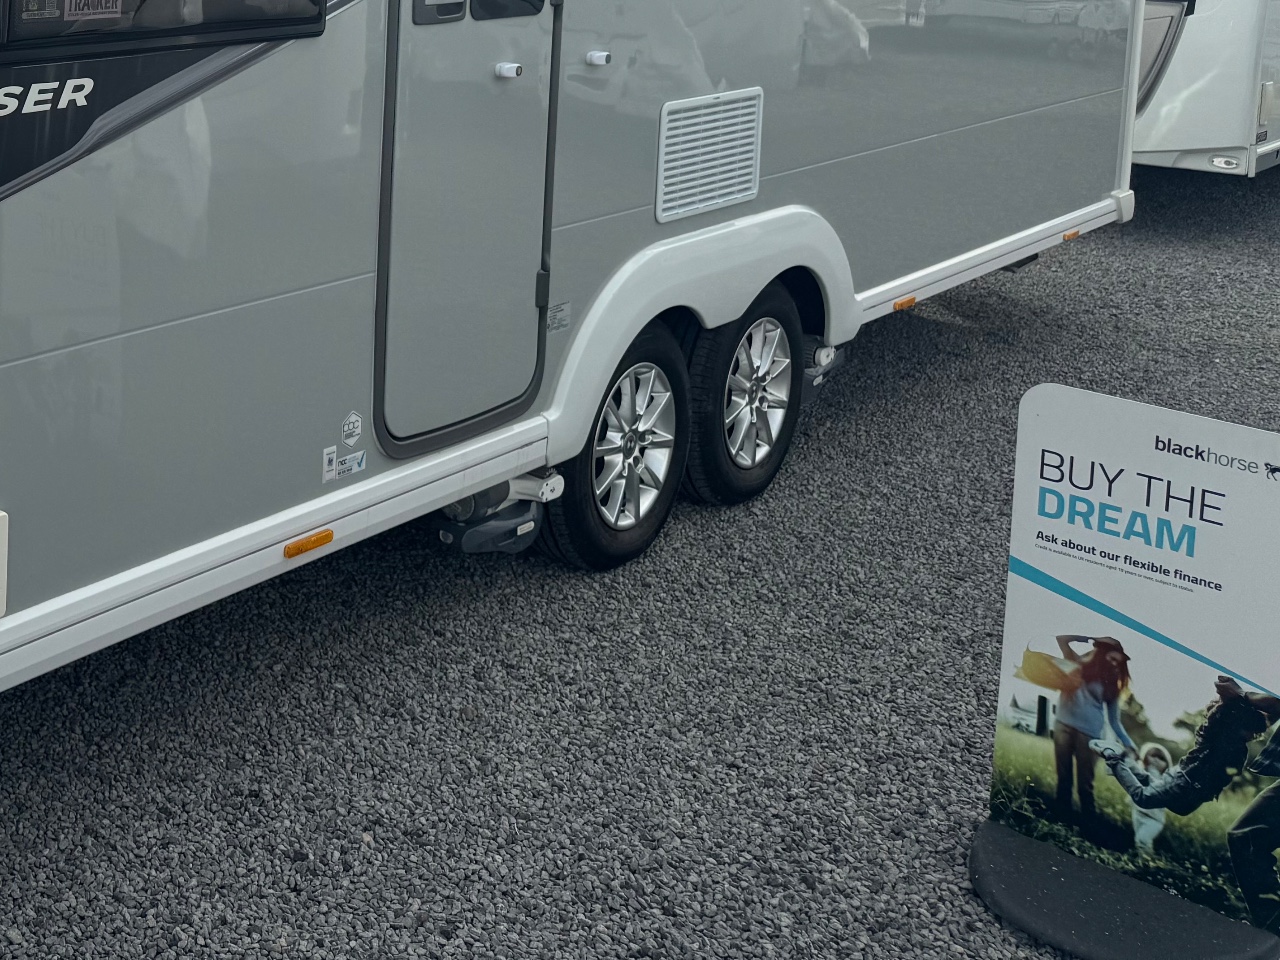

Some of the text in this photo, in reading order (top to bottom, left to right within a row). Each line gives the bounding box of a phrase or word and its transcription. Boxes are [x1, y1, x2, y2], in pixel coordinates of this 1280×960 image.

[1039, 448, 1226, 527] BUY THE
[1154, 435, 1259, 474] blackhorse
[1037, 485, 1197, 558] DREAM
[1036, 530, 1223, 592] Ask about our flexible finance
